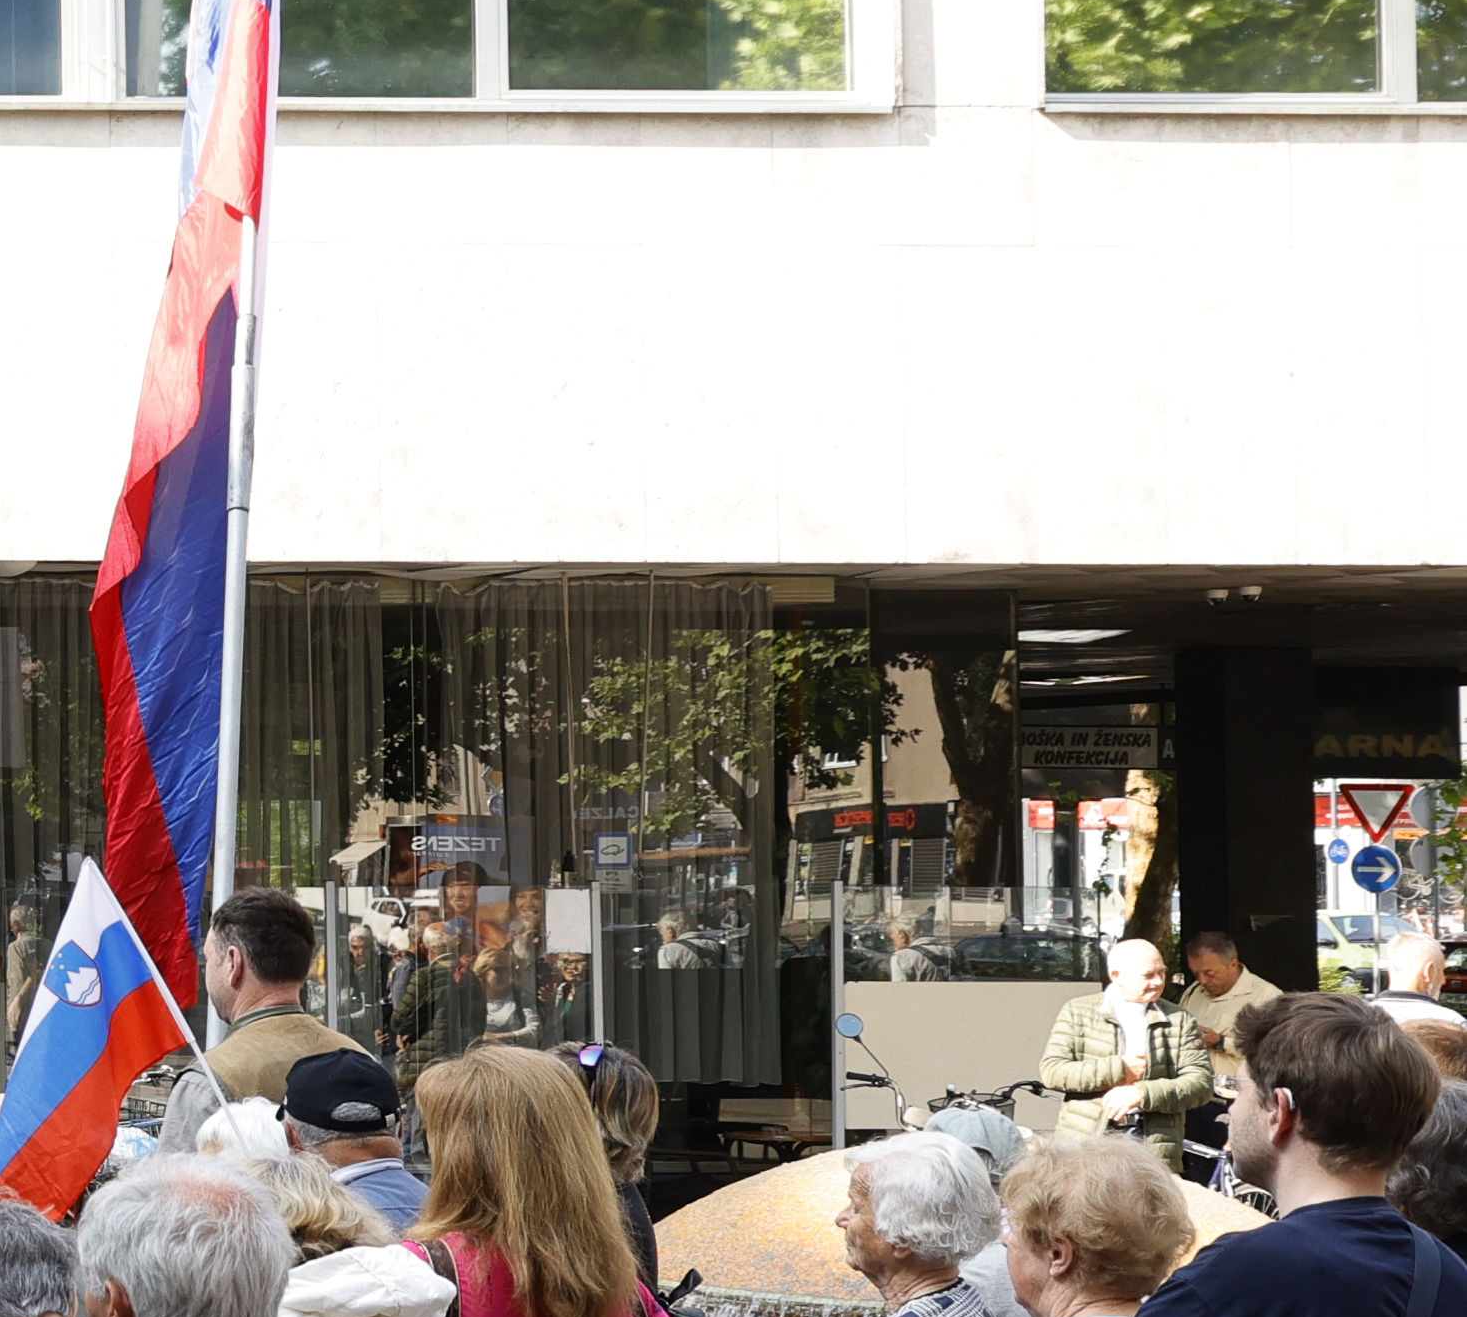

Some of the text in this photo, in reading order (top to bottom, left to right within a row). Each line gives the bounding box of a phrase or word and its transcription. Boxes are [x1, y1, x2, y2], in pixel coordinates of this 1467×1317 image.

[1071, 733, 1089, 747] IN
[1094, 729, 1151, 748] ŽENSKA
[1034, 750, 1129, 765] KONFEKCIJA
